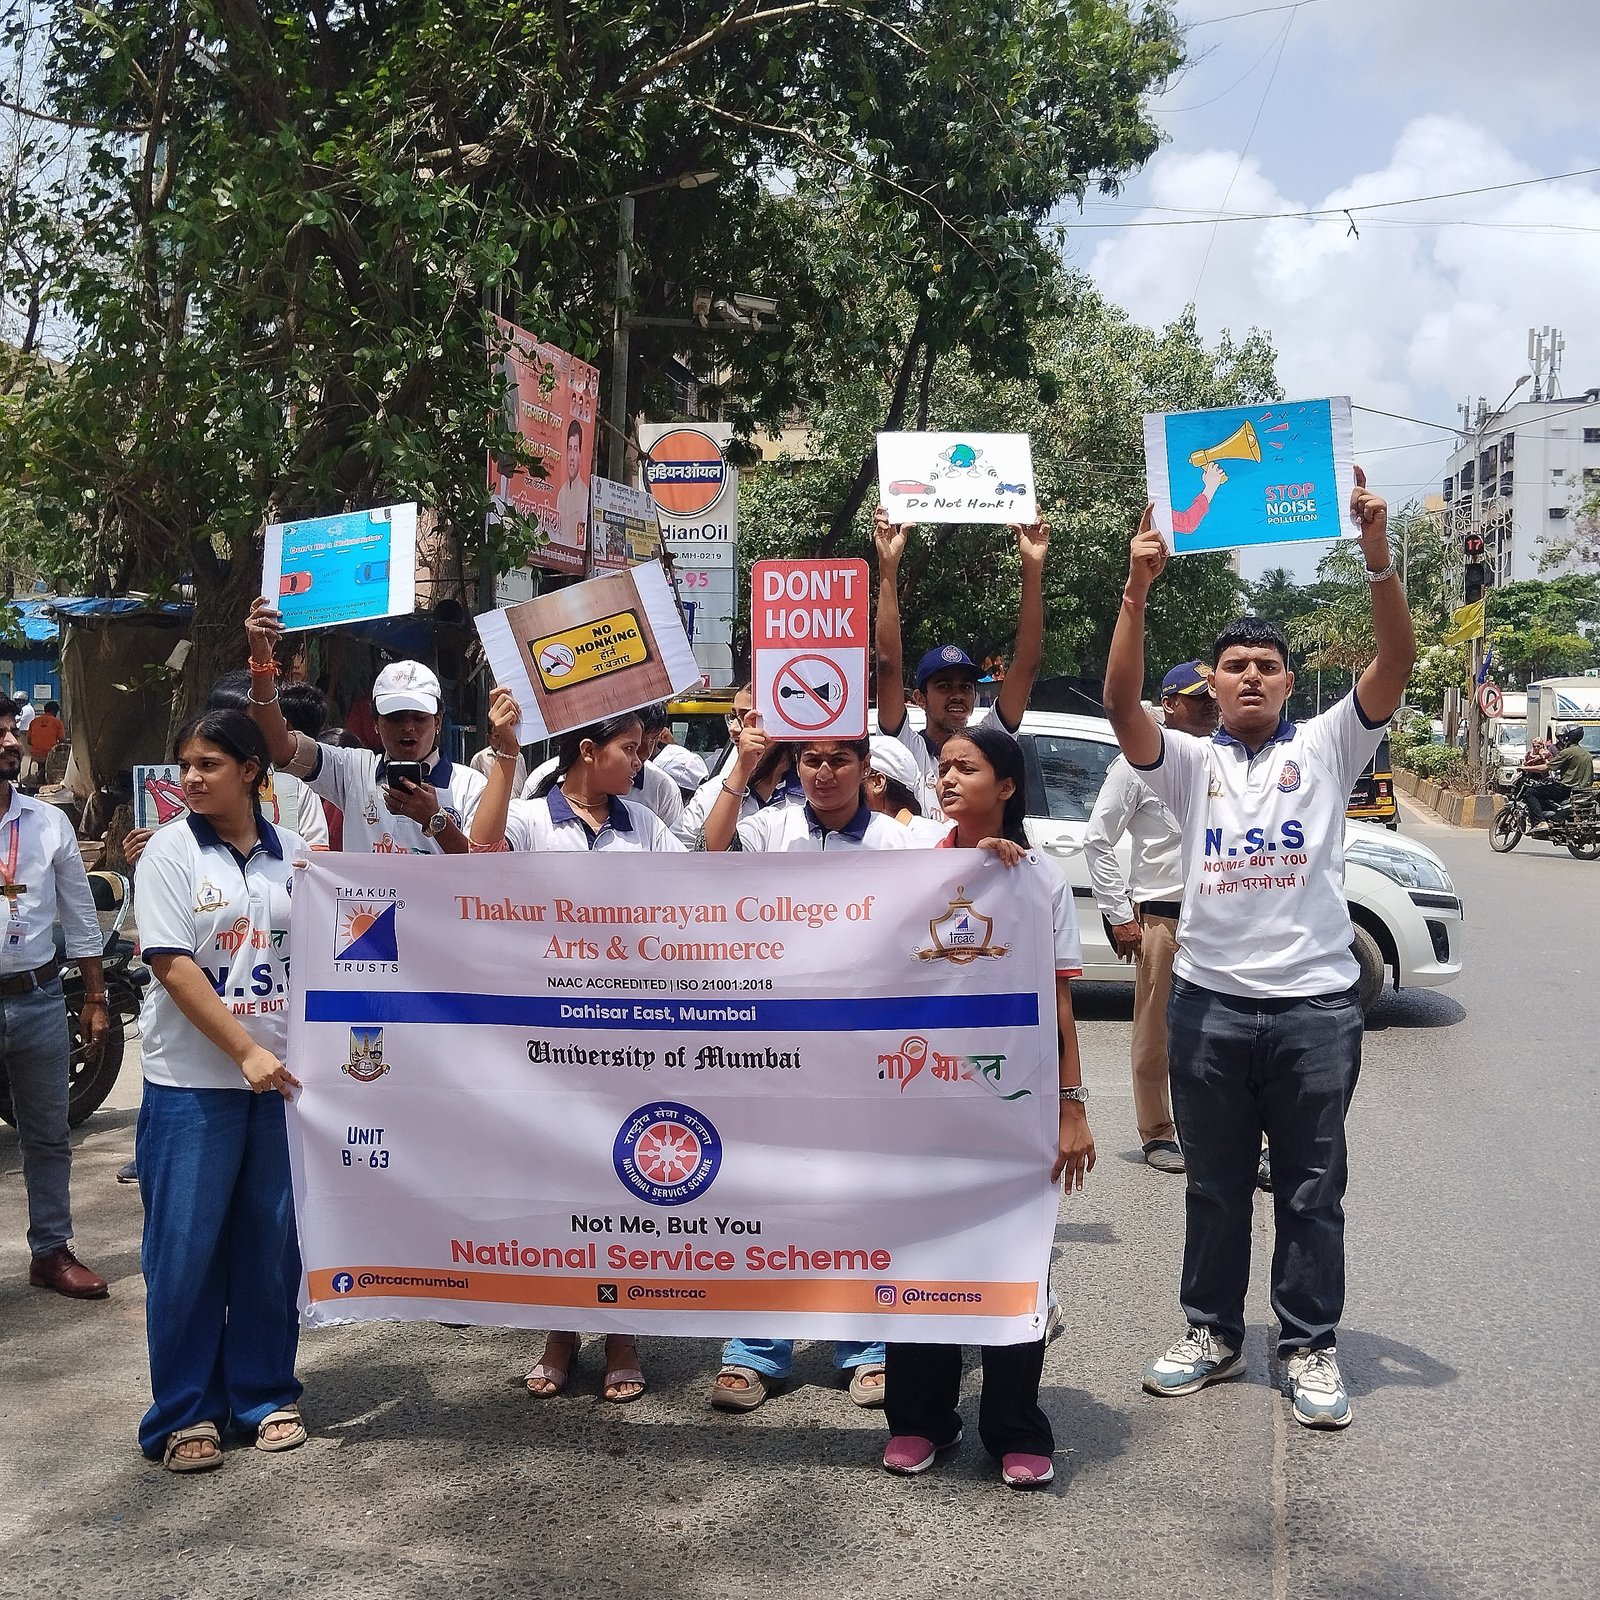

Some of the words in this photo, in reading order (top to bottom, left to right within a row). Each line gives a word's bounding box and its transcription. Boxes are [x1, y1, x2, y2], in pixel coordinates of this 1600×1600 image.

[1264, 482, 1315, 501] STOP
[906, 498, 929, 509] Do
[933, 497, 962, 509] Not
[967, 498, 1005, 509] Honk
[1266, 499, 1317, 516] NOISE
[1267, 513, 1318, 525] POLLUTION
[662, 524, 728, 541] dianOil
[763, 569, 858, 601] DON'T
[591, 624, 612, 639] NO
[765, 607, 855, 639] HONK
[574, 628, 637, 656] HONKING
[599, 644, 617, 661] हॉर्न
[591, 662, 604, 672] ना
[605, 653, 631, 670] बजाएं
[1226, 860, 1246, 871] ME
[1249, 855, 1276, 867] BUT
[1280, 853, 1308, 866] YOU
[335, 887, 397, 898] THAKUR
[1216, 879, 1238, 896] सेवा
[1241, 873, 1274, 891] परमो
[1274, 873, 1296, 888] धर्म
[454, 895, 547, 922] Thakur
[552, 898, 728, 930] Ramnarayan
[735, 895, 838, 929] College
[846, 895, 875, 921] of
[542, 934, 600, 960] Arts
[606, 935, 630, 961] &
[637, 935, 785, 961] Commerce
[334, 962, 399, 973] TRUSTS
[547, 976, 583, 989] NAAC
[586, 977, 667, 990] ACCREDITED
[676, 979, 699, 991] ISO
[701, 979, 773, 991] 21001:2018
[232, 1002, 256, 1015] ME
[260, 998, 285, 1014] BUT
[560, 1004, 628, 1020] Dahisar
[633, 1005, 675, 1023] East,
[679, 1005, 757, 1021] Mumbai
[527, 1039, 656, 1071] University
[664, 1046, 686, 1069] of
[694, 1044, 802, 1071] Mumbai
[347, 1126, 385, 1145] UNIT
[654, 1107, 679, 1119] सेवा
[684, 1114, 712, 1145] योजना
[341, 1149, 352, 1166] B
[369, 1149, 390, 1169] 63
[622, 1158, 650, 1193] NATIONAL
[652, 1186, 688, 1198] SERVICE
[687, 1158, 713, 1190] SCHEME
[571, 1215, 613, 1233] Not
[620, 1215, 661, 1238] Me,
[667, 1217, 708, 1235] But
[714, 1217, 762, 1235] You
[450, 1239, 596, 1269] National
[607, 1242, 735, 1271] Service
[745, 1244, 892, 1271] Scheme
[357, 1272, 469, 1293] @trcacmumbai
[627, 1285, 707, 1301] @nsstrcac
[902, 1288, 982, 1305] @trcacnss
